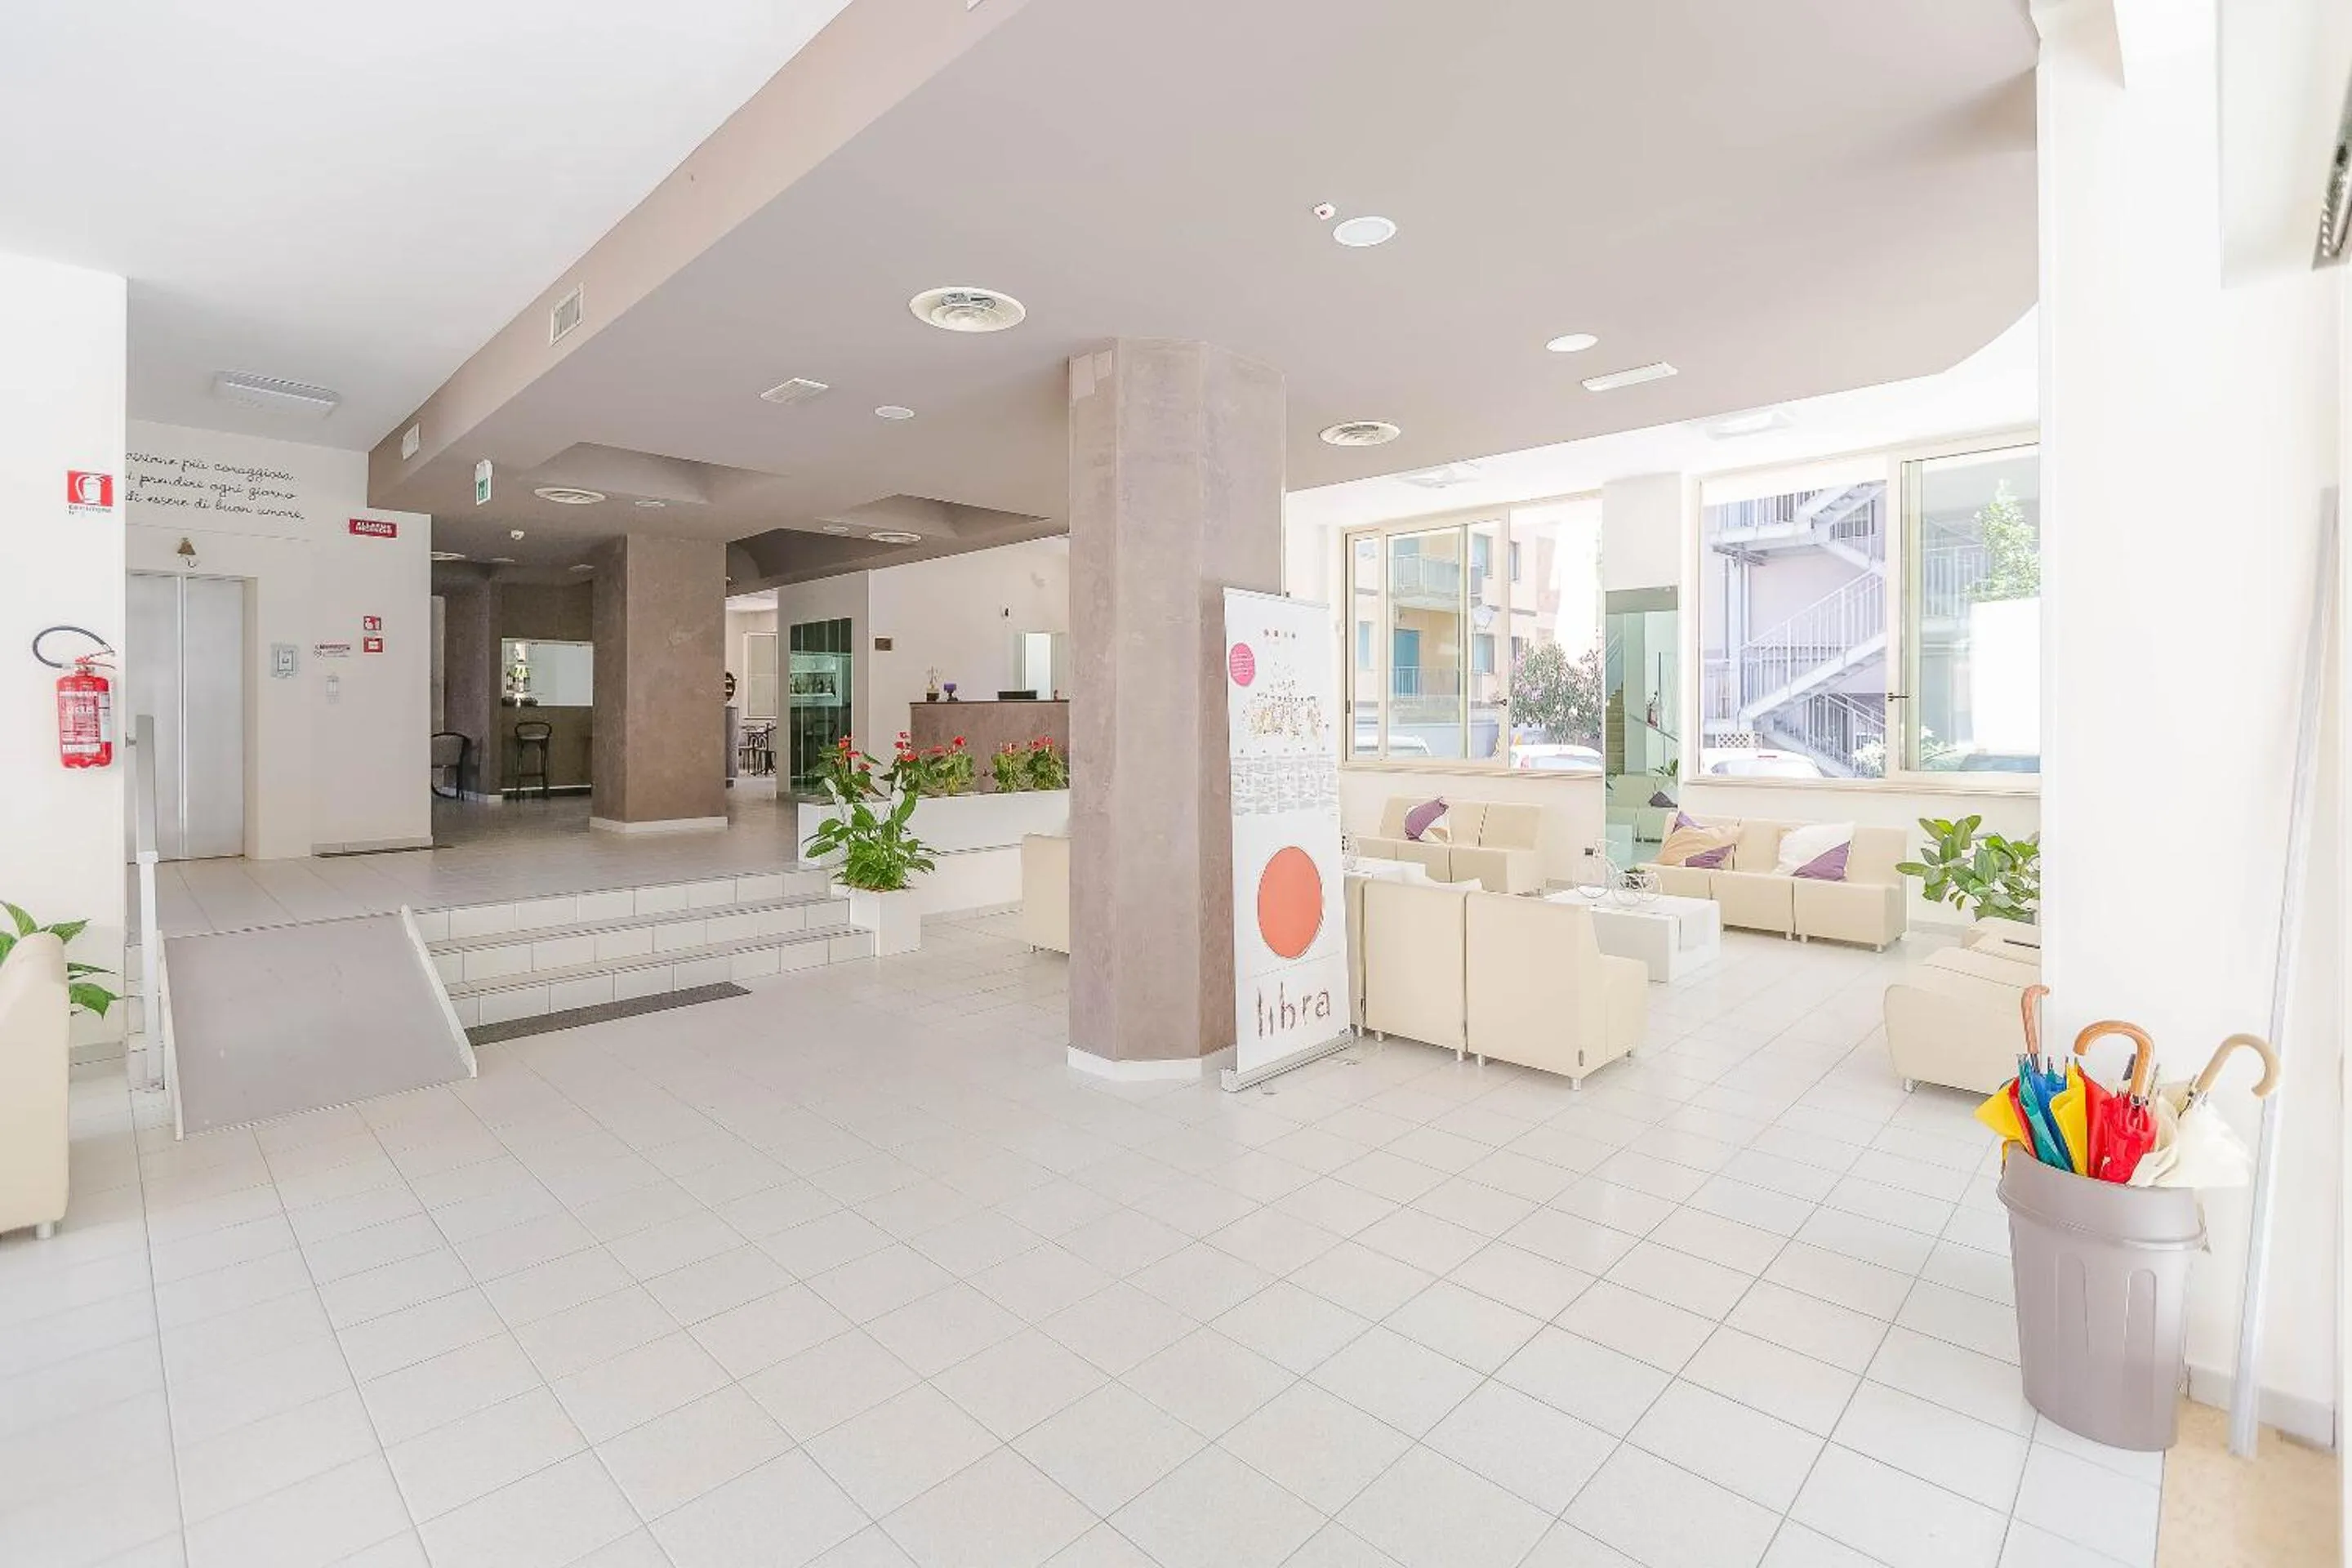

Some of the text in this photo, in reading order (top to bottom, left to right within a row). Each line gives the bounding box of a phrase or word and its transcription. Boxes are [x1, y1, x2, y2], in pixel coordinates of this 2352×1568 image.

[210, 483, 243, 497] ogni
[248, 487, 295, 500] giorno
[194, 497, 211, 508] di
[216, 499, 252, 513] buon
[1258, 981, 1330, 1039] libra
